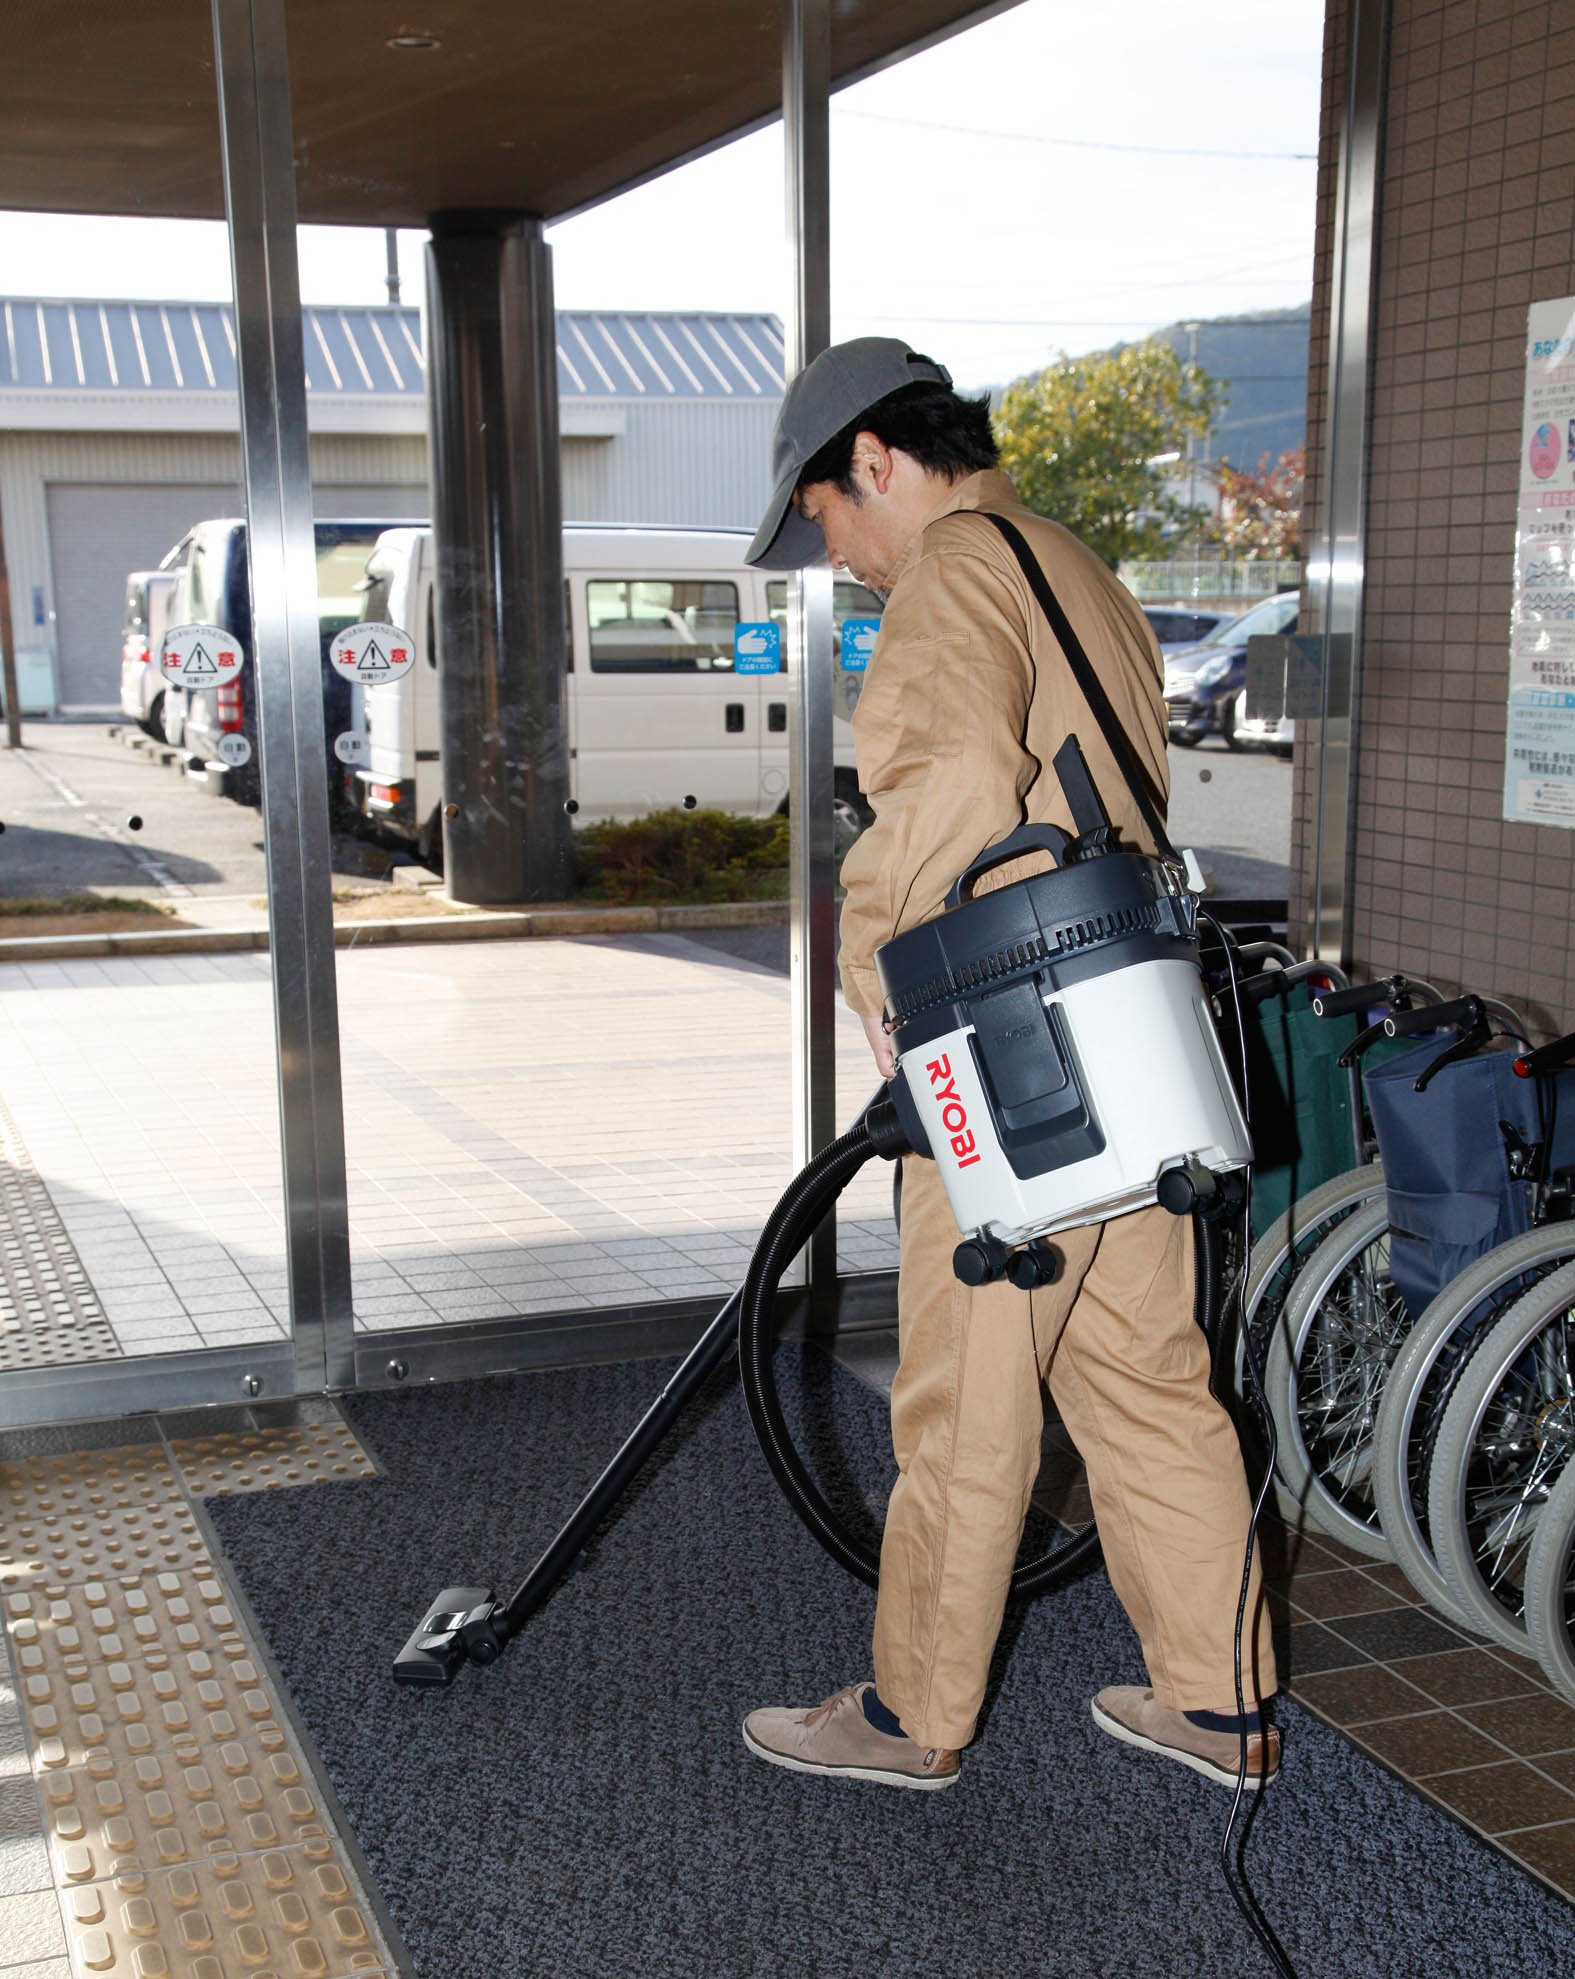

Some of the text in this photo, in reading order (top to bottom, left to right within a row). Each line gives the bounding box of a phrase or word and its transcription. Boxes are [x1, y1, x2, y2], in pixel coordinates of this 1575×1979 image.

[162, 651, 236, 668] 注 意
[338, 648, 408, 664] 注 意
[925, 1053, 981, 1169] RYOBI
